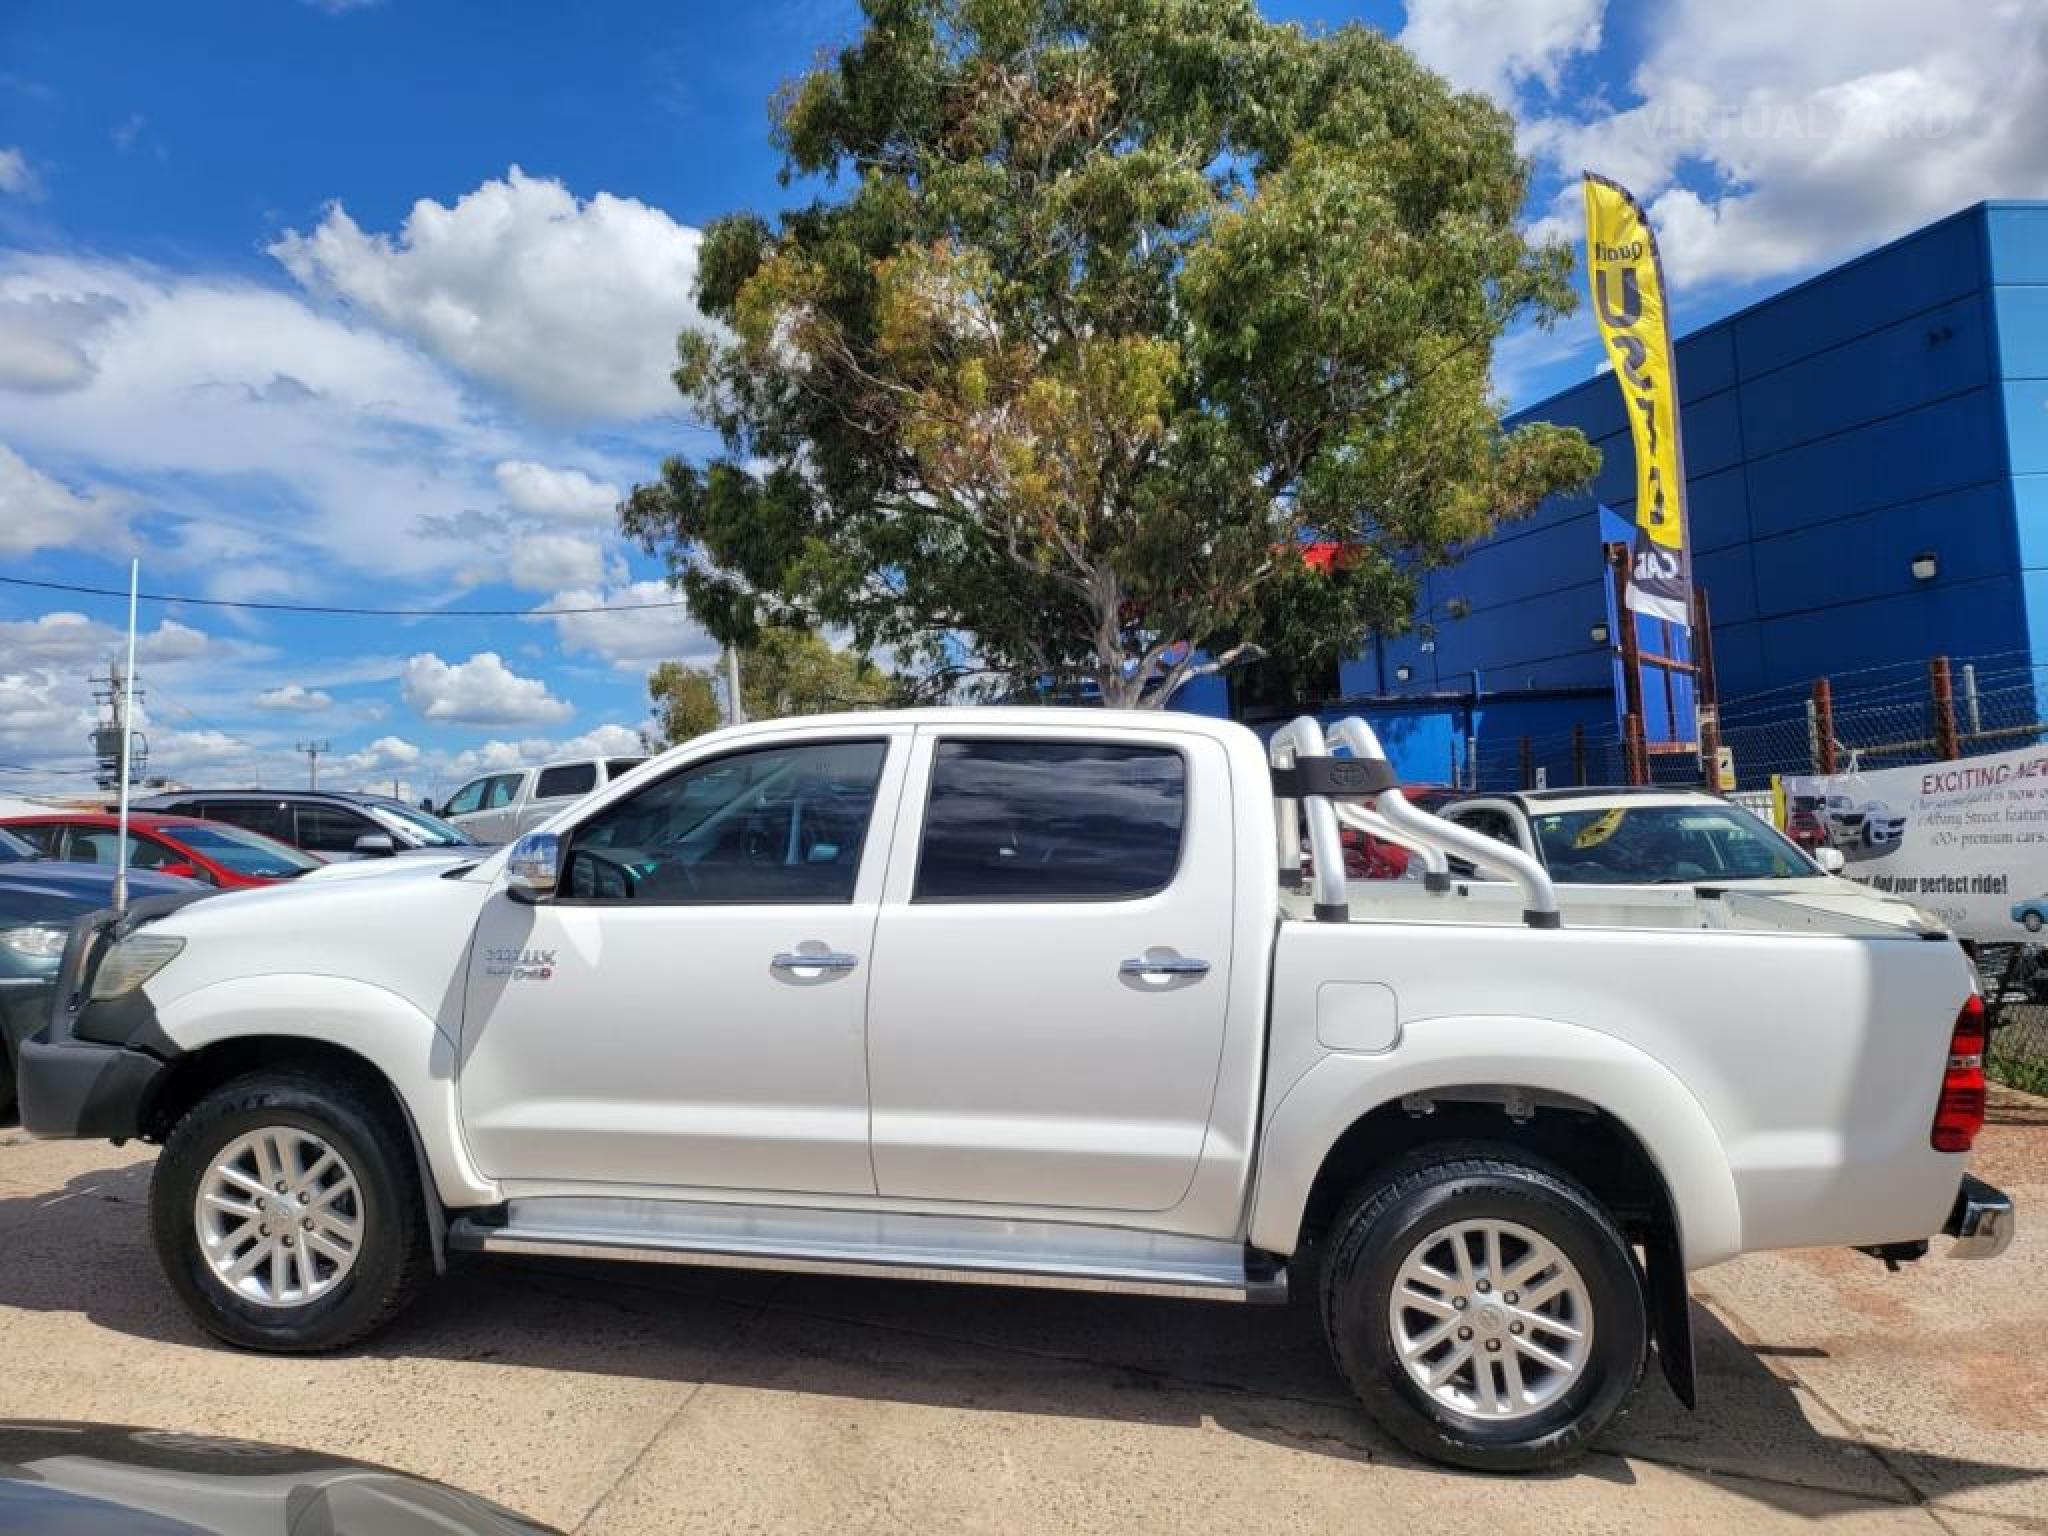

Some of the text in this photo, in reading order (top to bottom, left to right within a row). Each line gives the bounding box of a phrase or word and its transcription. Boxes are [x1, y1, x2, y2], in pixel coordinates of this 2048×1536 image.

[1921, 764, 2011, 795] EXCITING
[1919, 874, 1969, 895] perfect
[1971, 873, 2008, 895] ride!
